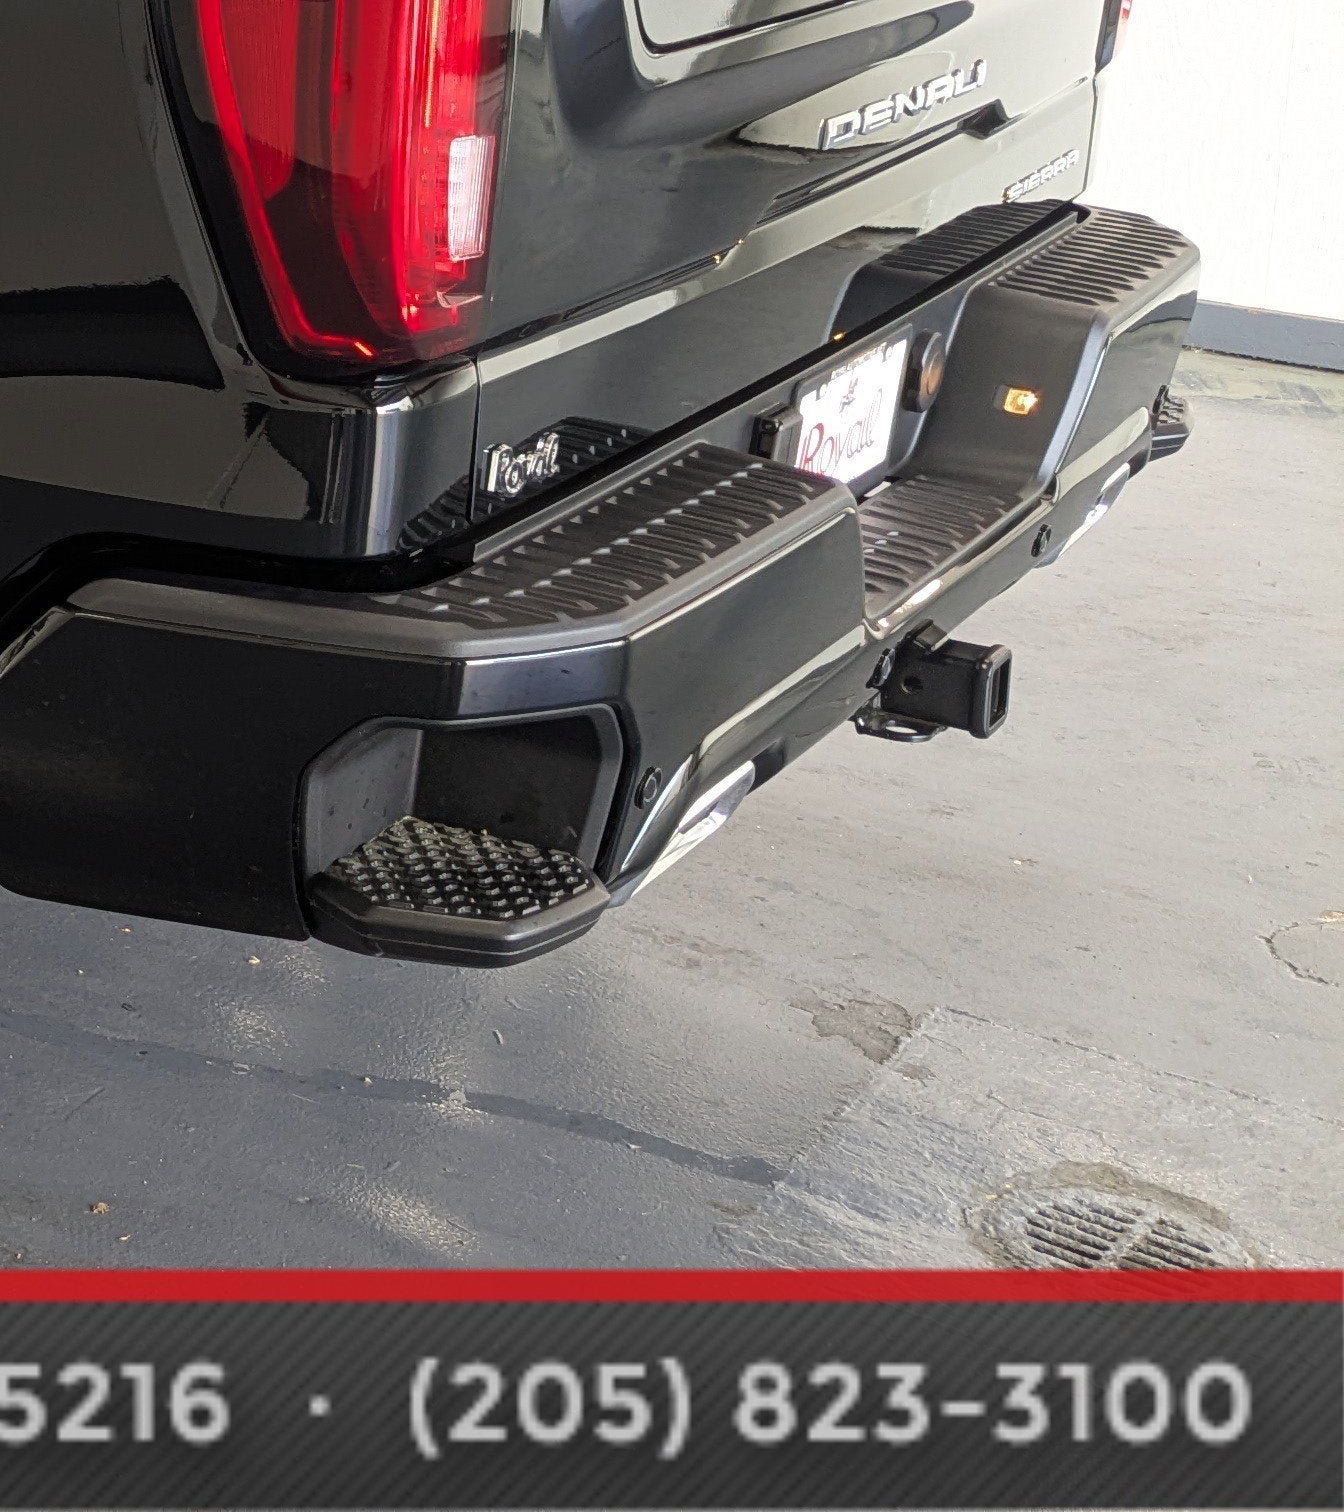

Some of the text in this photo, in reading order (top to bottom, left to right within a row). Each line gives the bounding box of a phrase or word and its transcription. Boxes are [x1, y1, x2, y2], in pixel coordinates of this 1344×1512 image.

[817, 57, 987, 151] DENALI
[1000, 148, 1080, 202] SIERRA
[797, 387, 884, 476] Royal
